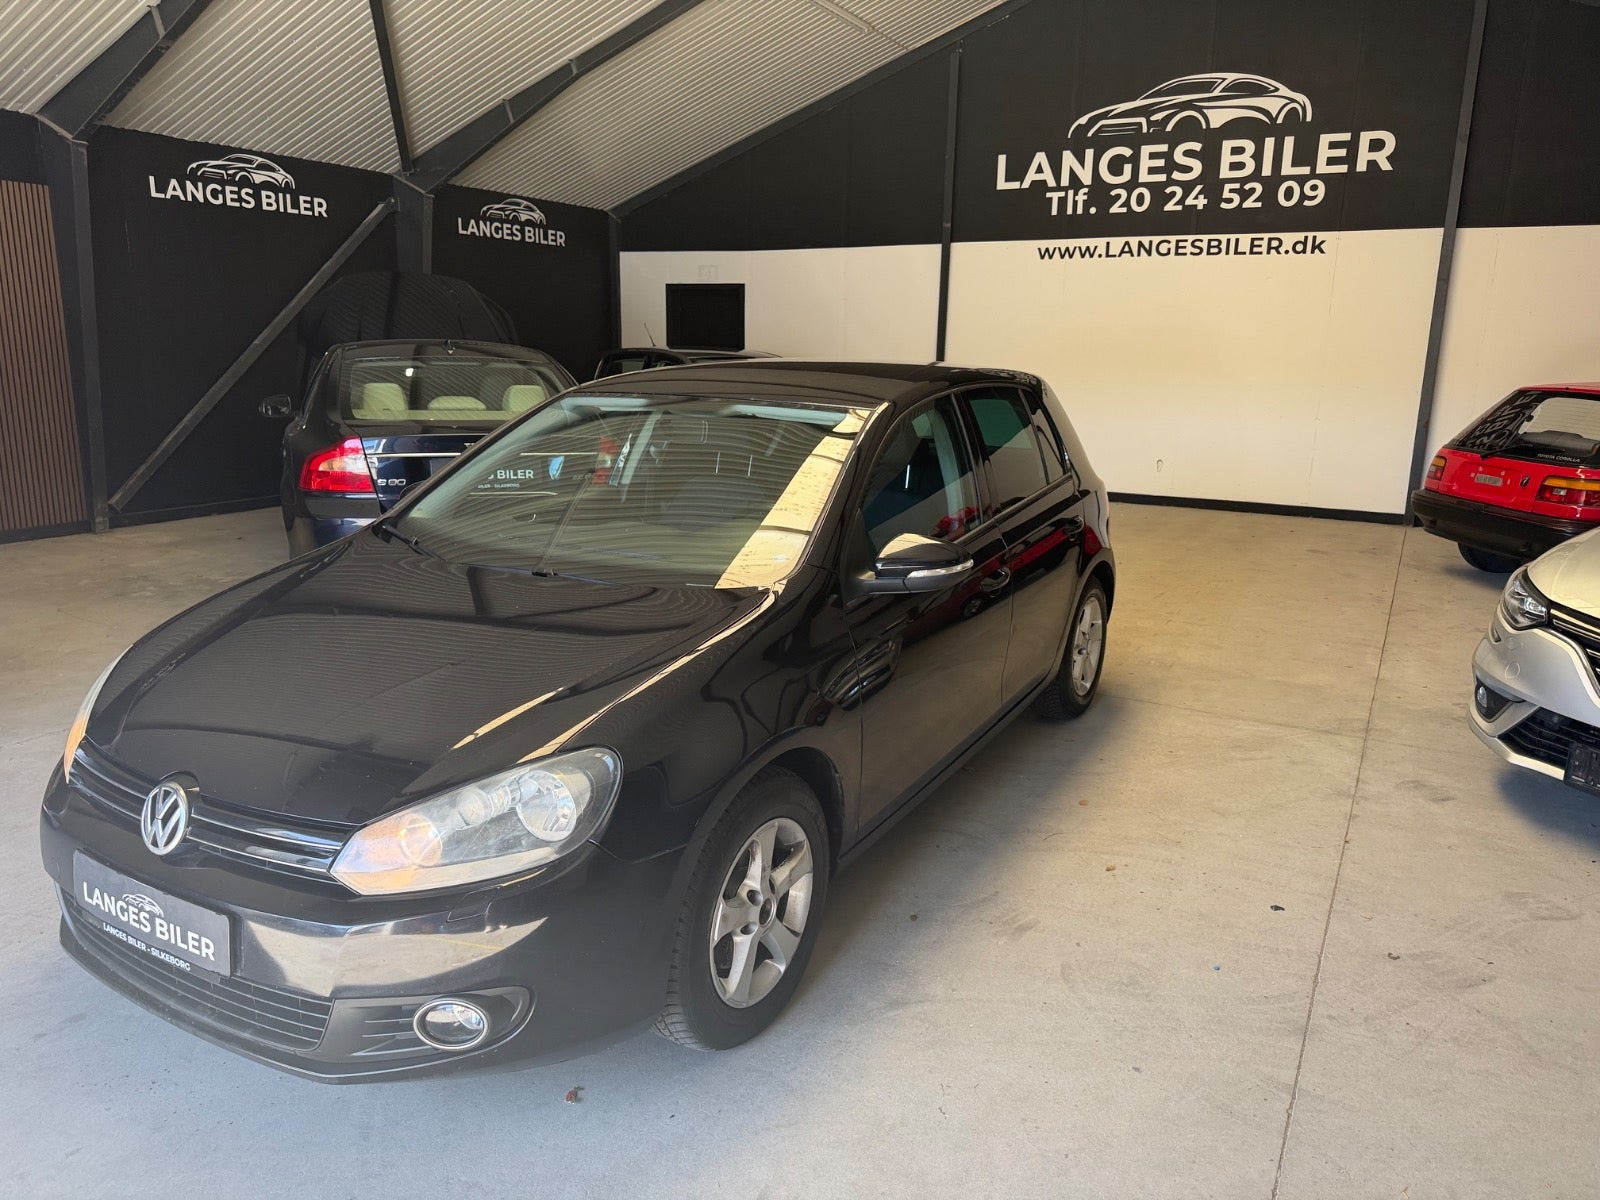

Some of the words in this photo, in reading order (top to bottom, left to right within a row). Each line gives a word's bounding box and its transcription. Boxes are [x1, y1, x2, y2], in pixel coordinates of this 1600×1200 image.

[996, 142, 1203, 190] LANGES
[1218, 130, 1397, 179] BILER
[149, 175, 256, 209] LANGES
[261, 190, 328, 218] BILER
[1046, 188, 1097, 216] Tlf.
[1109, 187, 1151, 214] 20
[1163, 184, 1208, 212] 24
[1219, 182, 1263, 210] 52
[1277, 179, 1326, 207] 09
[458, 217, 521, 241] LANGES
[524, 226, 566, 247] BILER
[1037, 235, 1326, 260] www.LANGESBILER.dk
[497, 469, 534, 479] BILER
[83, 881, 151, 933] LANGES
[155, 917, 215, 961] BILER
[103, 922, 127, 941] LANGES
[128, 937, 147, 952] BILER
[151, 947, 191, 971] SILKEBORG
